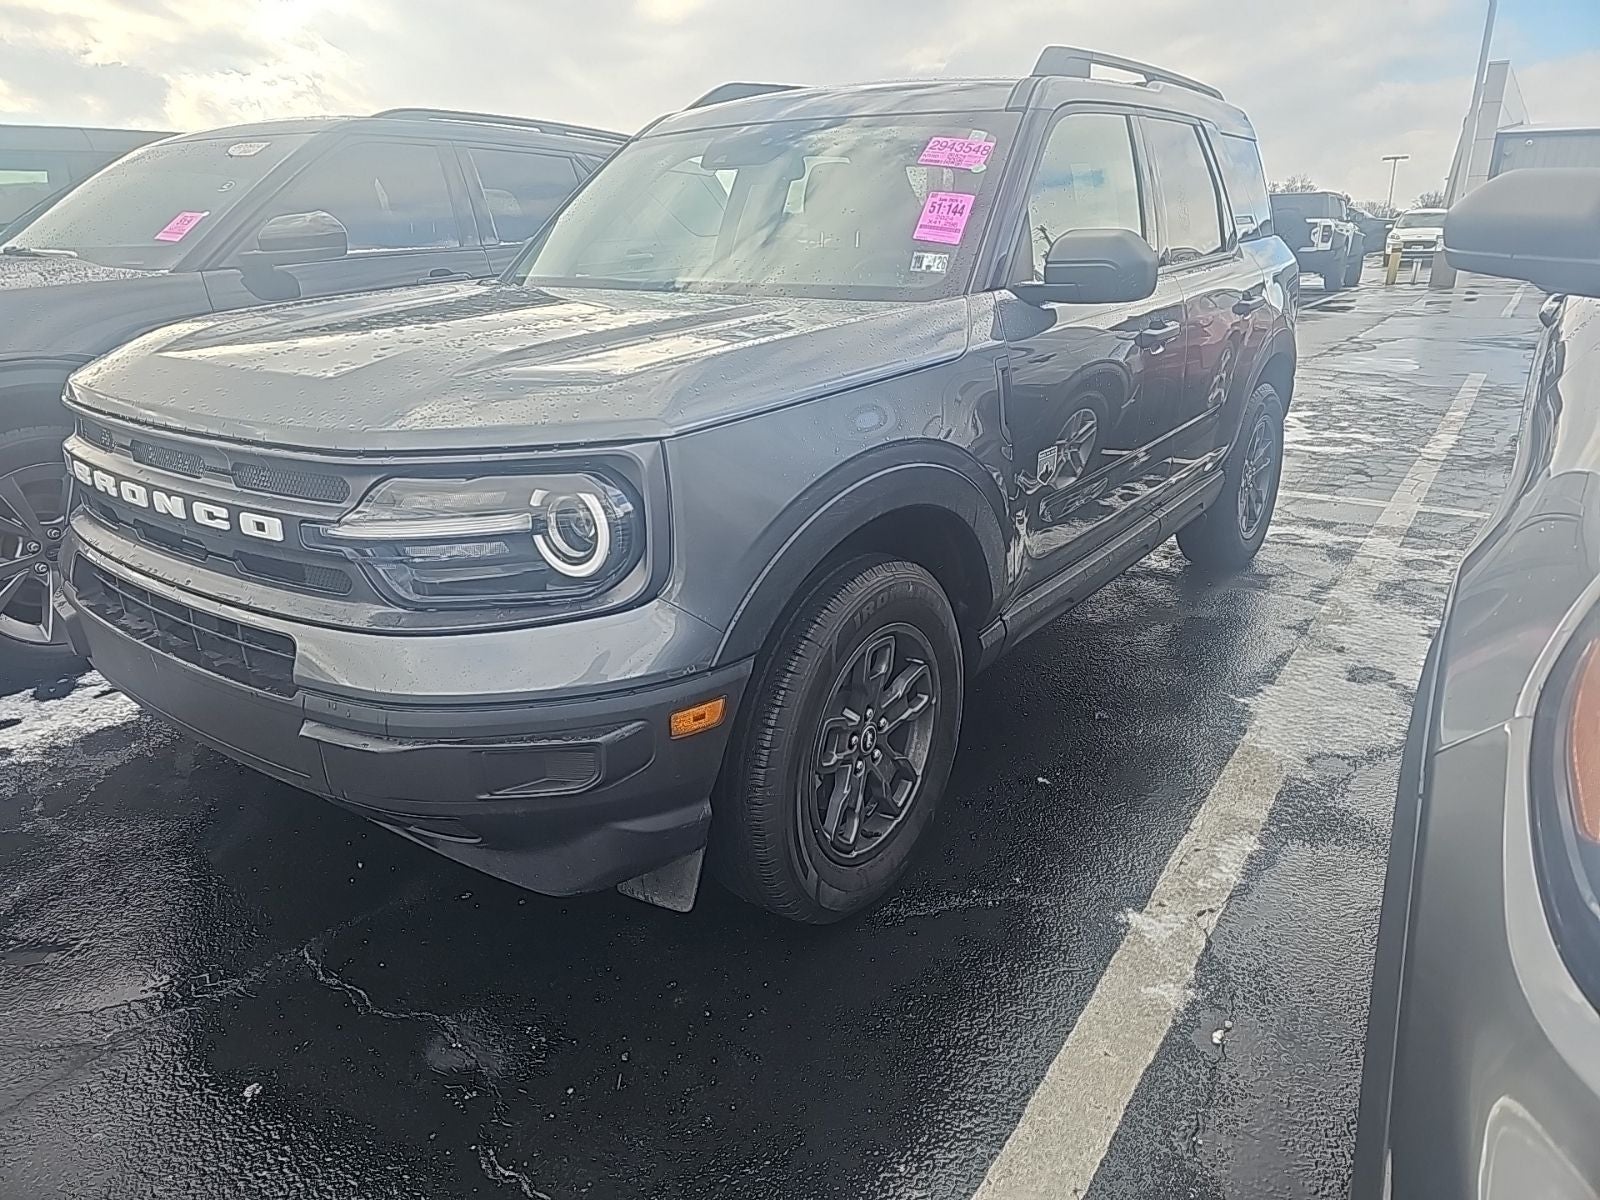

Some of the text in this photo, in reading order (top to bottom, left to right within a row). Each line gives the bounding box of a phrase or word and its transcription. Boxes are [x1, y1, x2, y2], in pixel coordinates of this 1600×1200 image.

[929, 140, 992, 156] 2943548
[928, 202, 965, 216] 51:144
[73, 459, 285, 542] BRONCO
